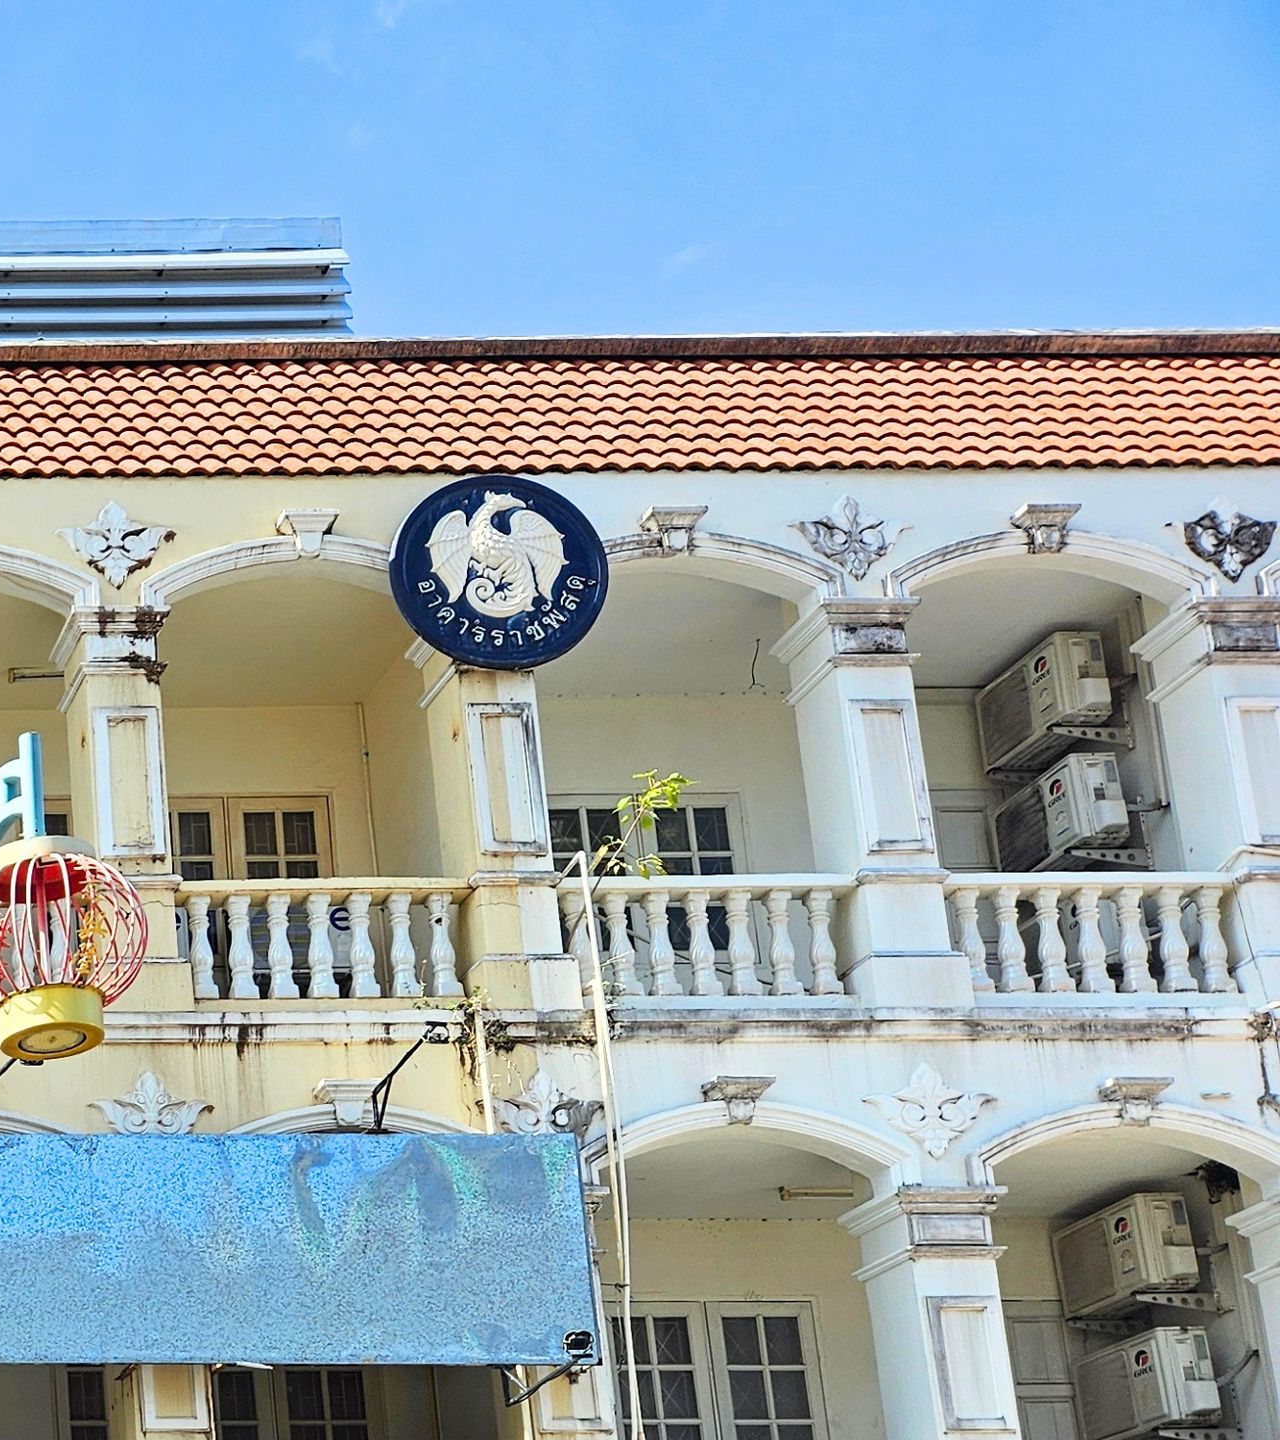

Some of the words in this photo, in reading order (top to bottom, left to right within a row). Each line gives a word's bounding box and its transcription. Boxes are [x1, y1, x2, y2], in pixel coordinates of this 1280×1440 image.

[417, 574, 597, 647] อาคารราชพัสดุ
